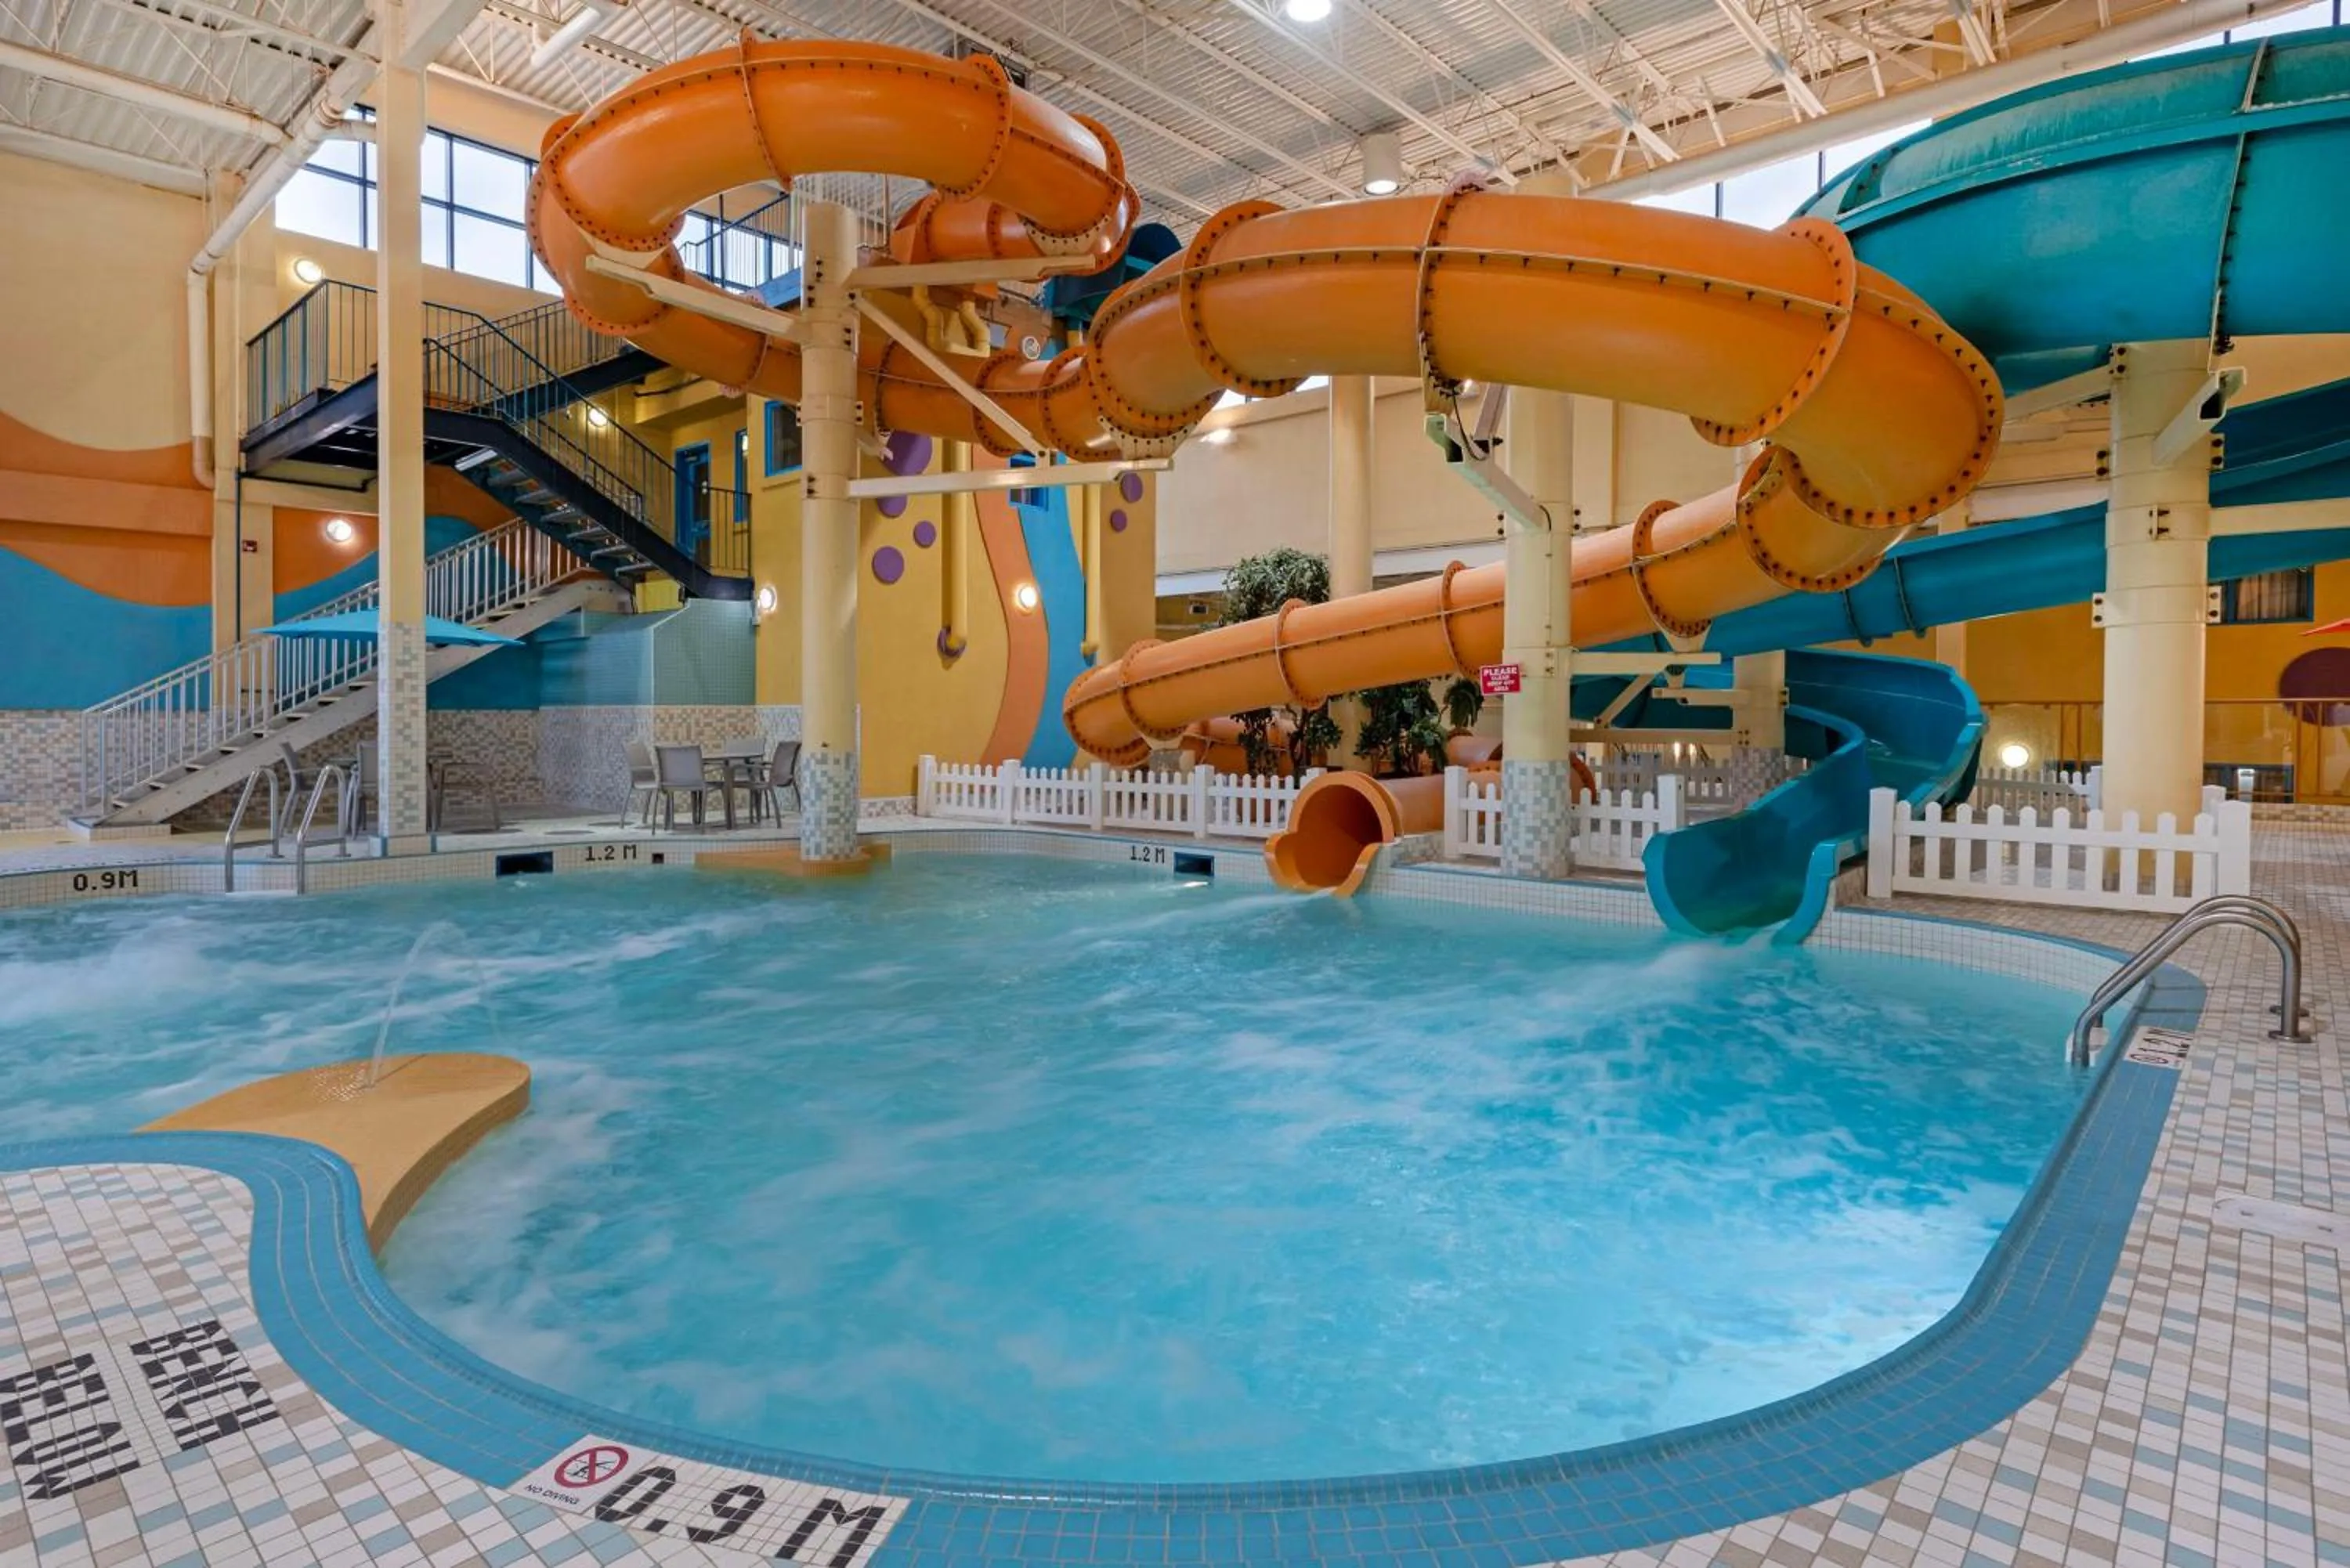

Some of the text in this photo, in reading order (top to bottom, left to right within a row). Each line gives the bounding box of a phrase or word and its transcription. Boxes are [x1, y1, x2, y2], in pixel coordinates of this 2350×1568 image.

[1483, 667, 1517, 676] PLEASE
[586, 844, 637, 862] 1.2 M
[1130, 845, 1151, 862] 1.2
[130, 1320, 280, 1451] BENCH
[0, 1353, 141, 1499] BELOW
[524, 1483, 580, 1505] NO DIVING
[595, 1465, 887, 1568] 0.9 M
